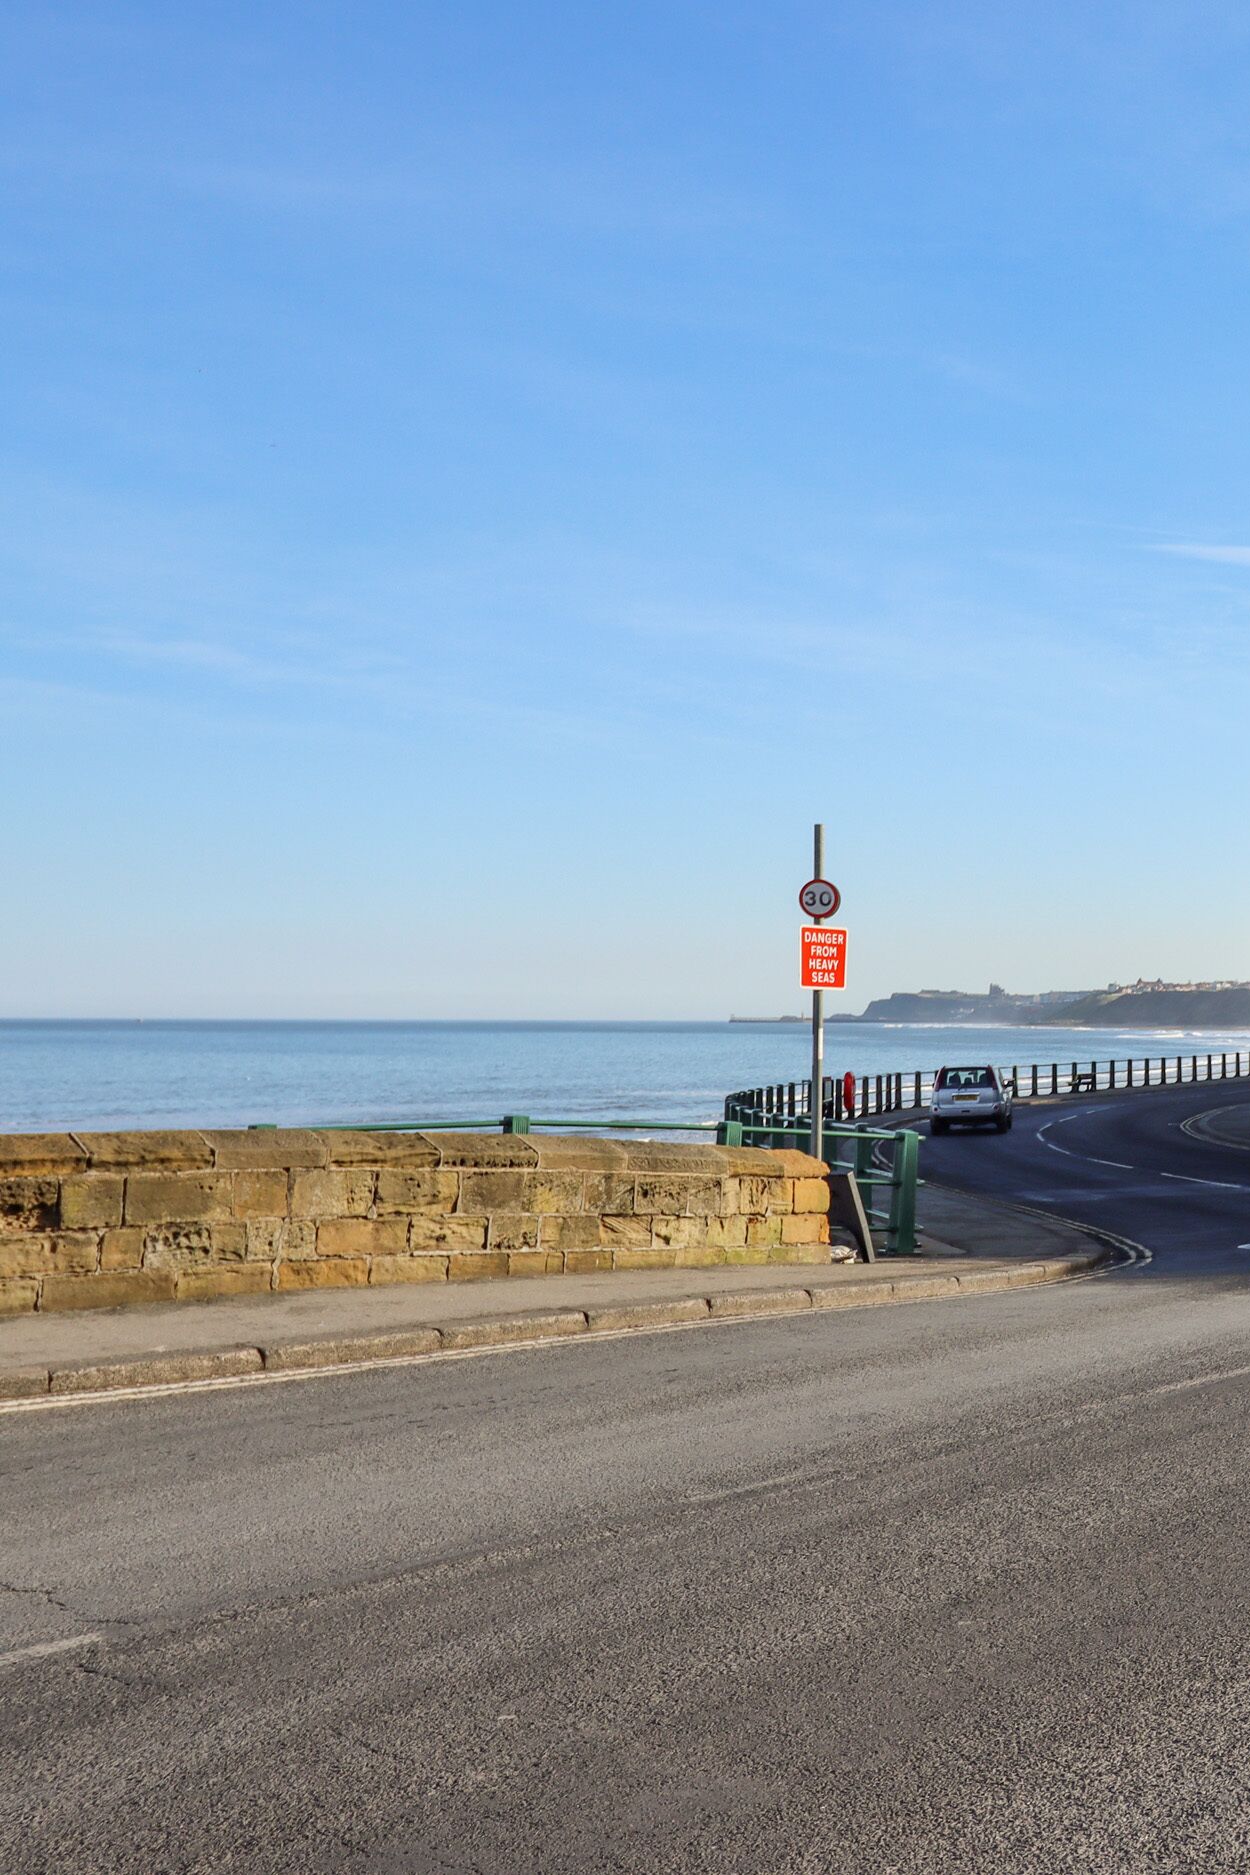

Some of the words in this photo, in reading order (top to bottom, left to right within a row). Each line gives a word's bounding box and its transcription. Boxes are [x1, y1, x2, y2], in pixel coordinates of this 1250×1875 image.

[805, 891, 832, 907] 30
[804, 932, 844, 944] DANGER
[811, 945, 837, 957] FROM
[809, 959, 839, 970] HEAVY
[811, 971, 835, 983] SEAS
